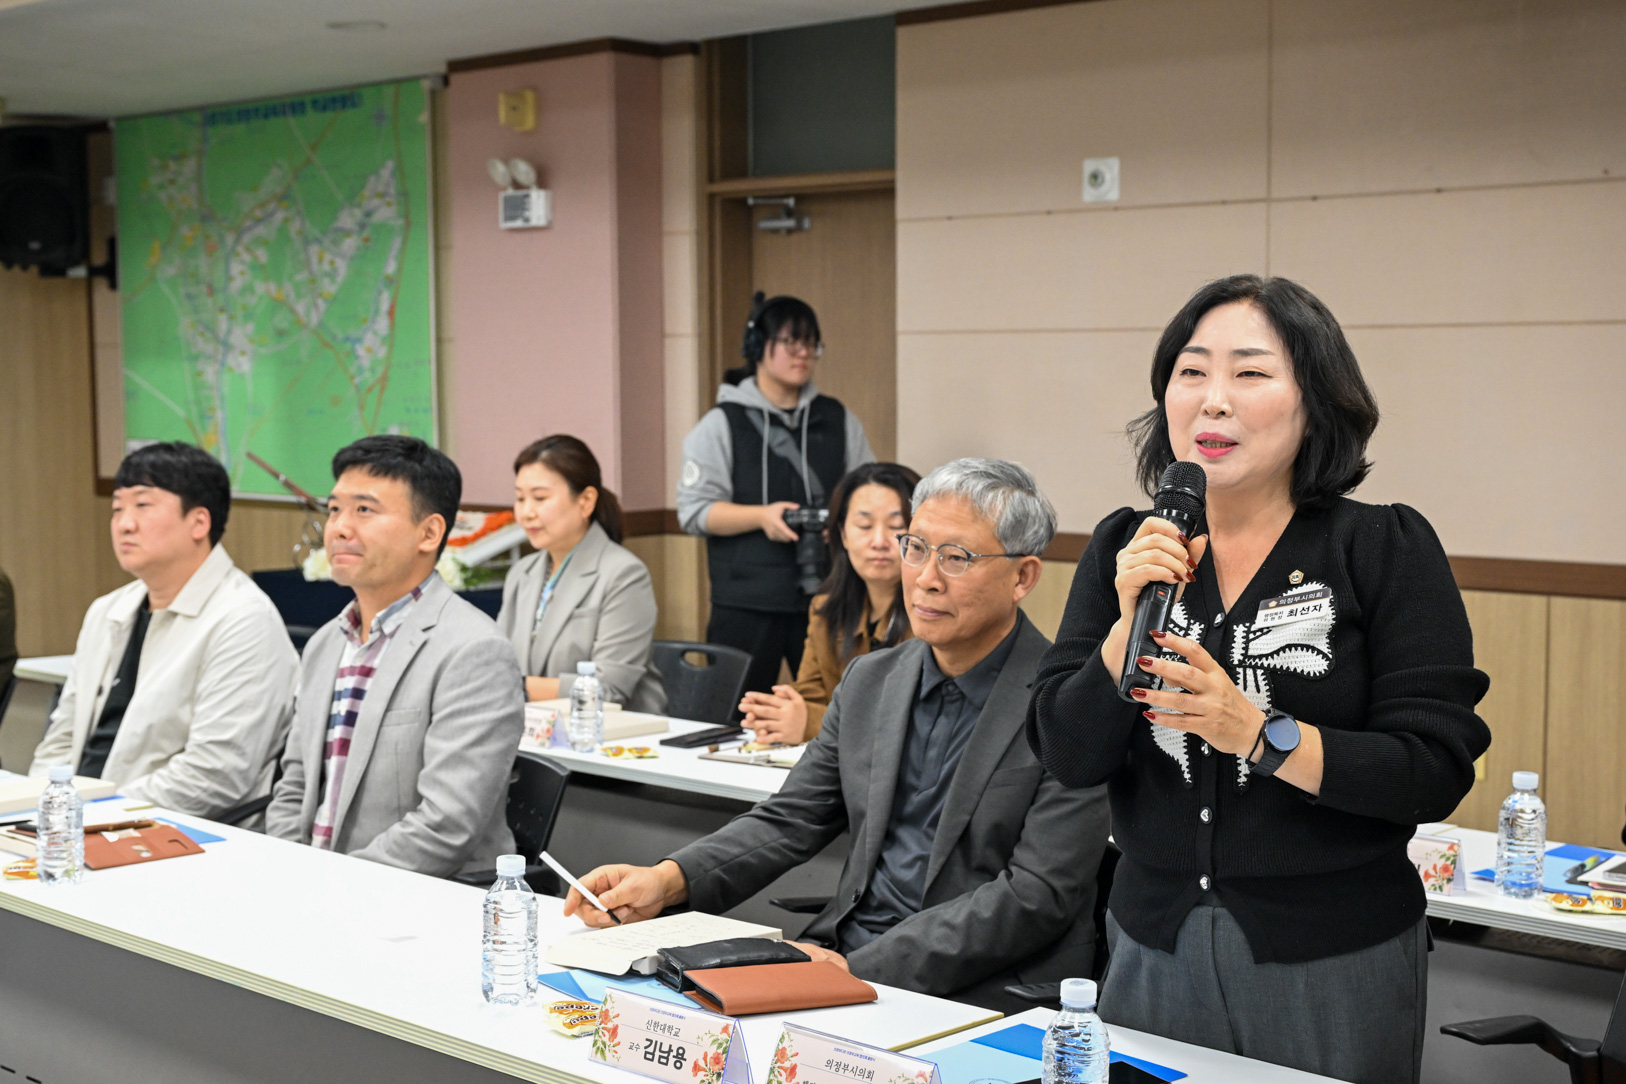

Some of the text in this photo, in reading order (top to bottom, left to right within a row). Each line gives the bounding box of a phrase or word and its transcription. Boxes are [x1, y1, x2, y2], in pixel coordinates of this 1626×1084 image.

[1279, 591, 1323, 605] 의정부시의회
[1287, 603, 1323, 618] 최선자
[645, 1019, 681, 1038] 신한대학교
[628, 1037, 687, 1070] 교수 김남용
[824, 1058, 875, 1082] 의정부시의회
